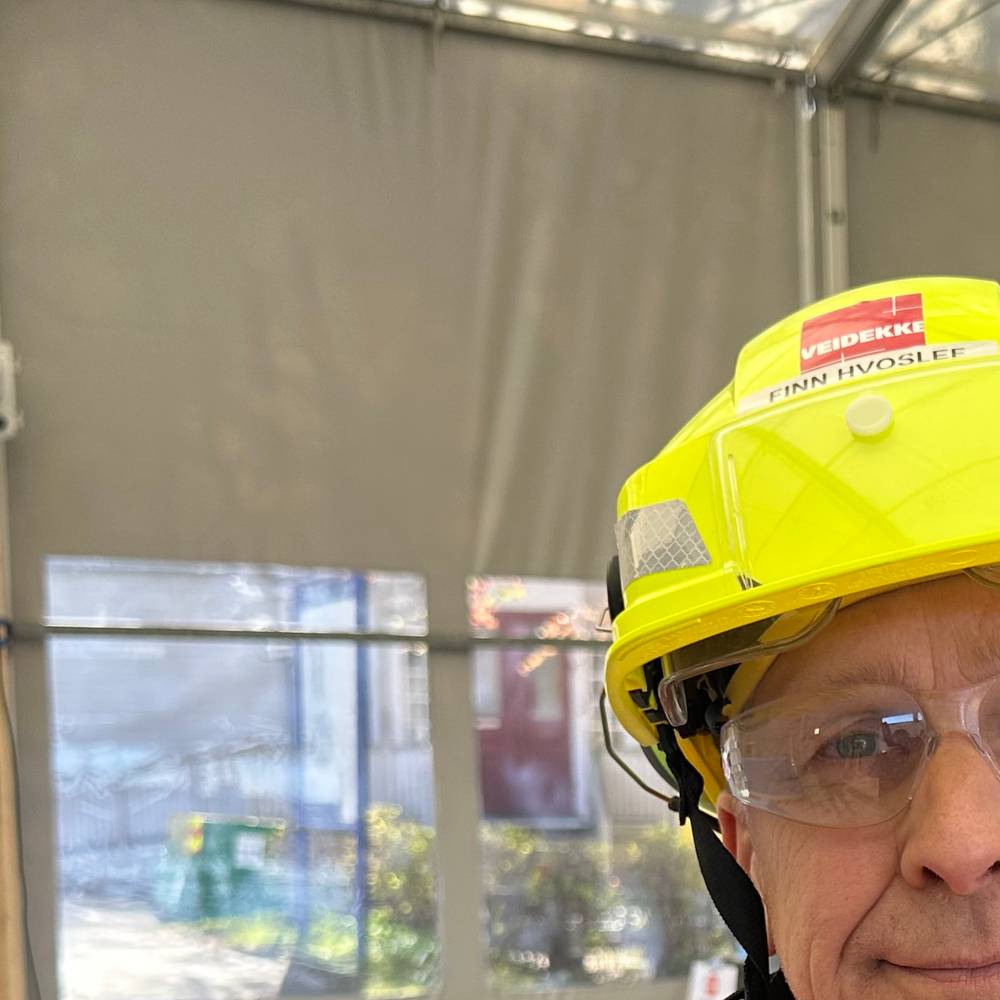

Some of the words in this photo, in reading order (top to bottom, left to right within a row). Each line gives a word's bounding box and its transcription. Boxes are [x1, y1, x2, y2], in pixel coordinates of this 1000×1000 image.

[801, 320, 926, 360] VEIDEKKE
[769, 372, 828, 403] FINN
[837, 347, 966, 381] HVOSLEF
